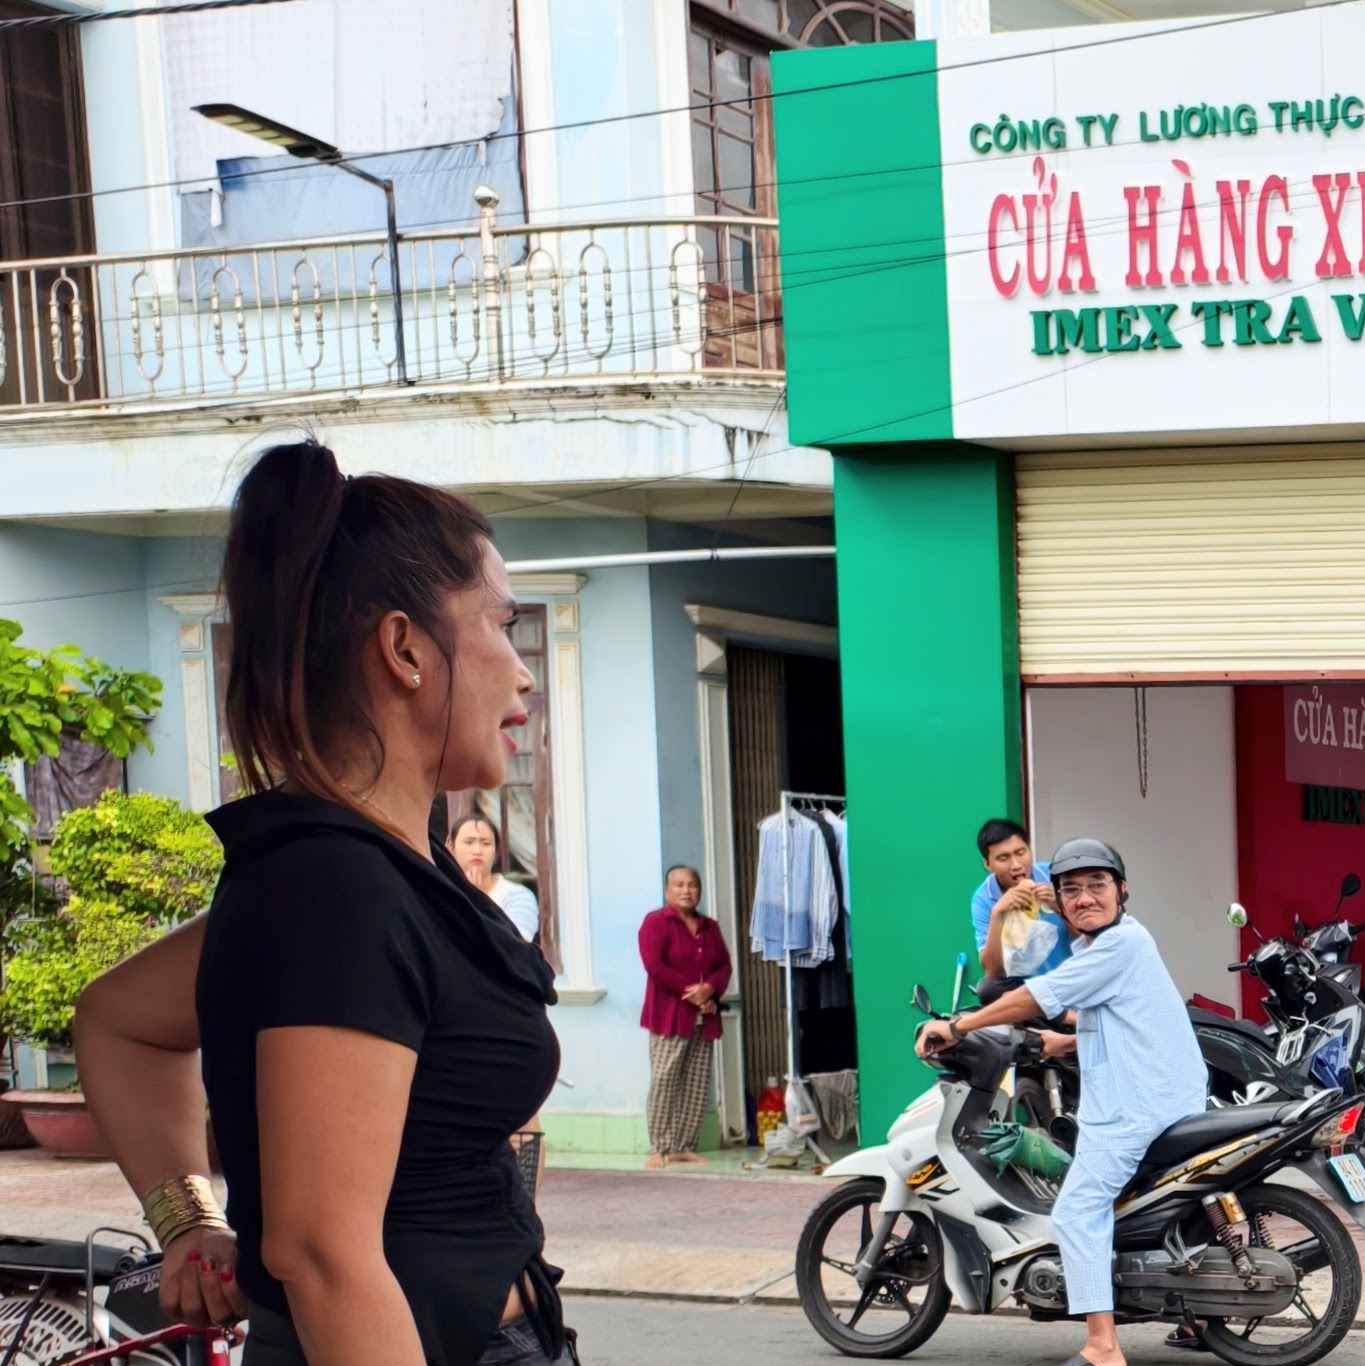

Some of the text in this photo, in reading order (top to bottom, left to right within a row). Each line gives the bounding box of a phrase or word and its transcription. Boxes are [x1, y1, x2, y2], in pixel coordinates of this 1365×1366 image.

[970, 113, 1067, 153] CÔNG
[1076, 113, 1119, 147] TY
[1139, 102, 1258, 144] LƯƠNG
[1268, 93, 1365, 138] THỰC
[988, 156, 1098, 298] CỬA
[1123, 158, 1294, 289] HÀNG
[1030, 303, 1181, 356] IMEX
[1191, 295, 1321, 347] TRA
[1293, 685, 1338, 747] CỬA
[1304, 785, 1365, 826] IMEX
